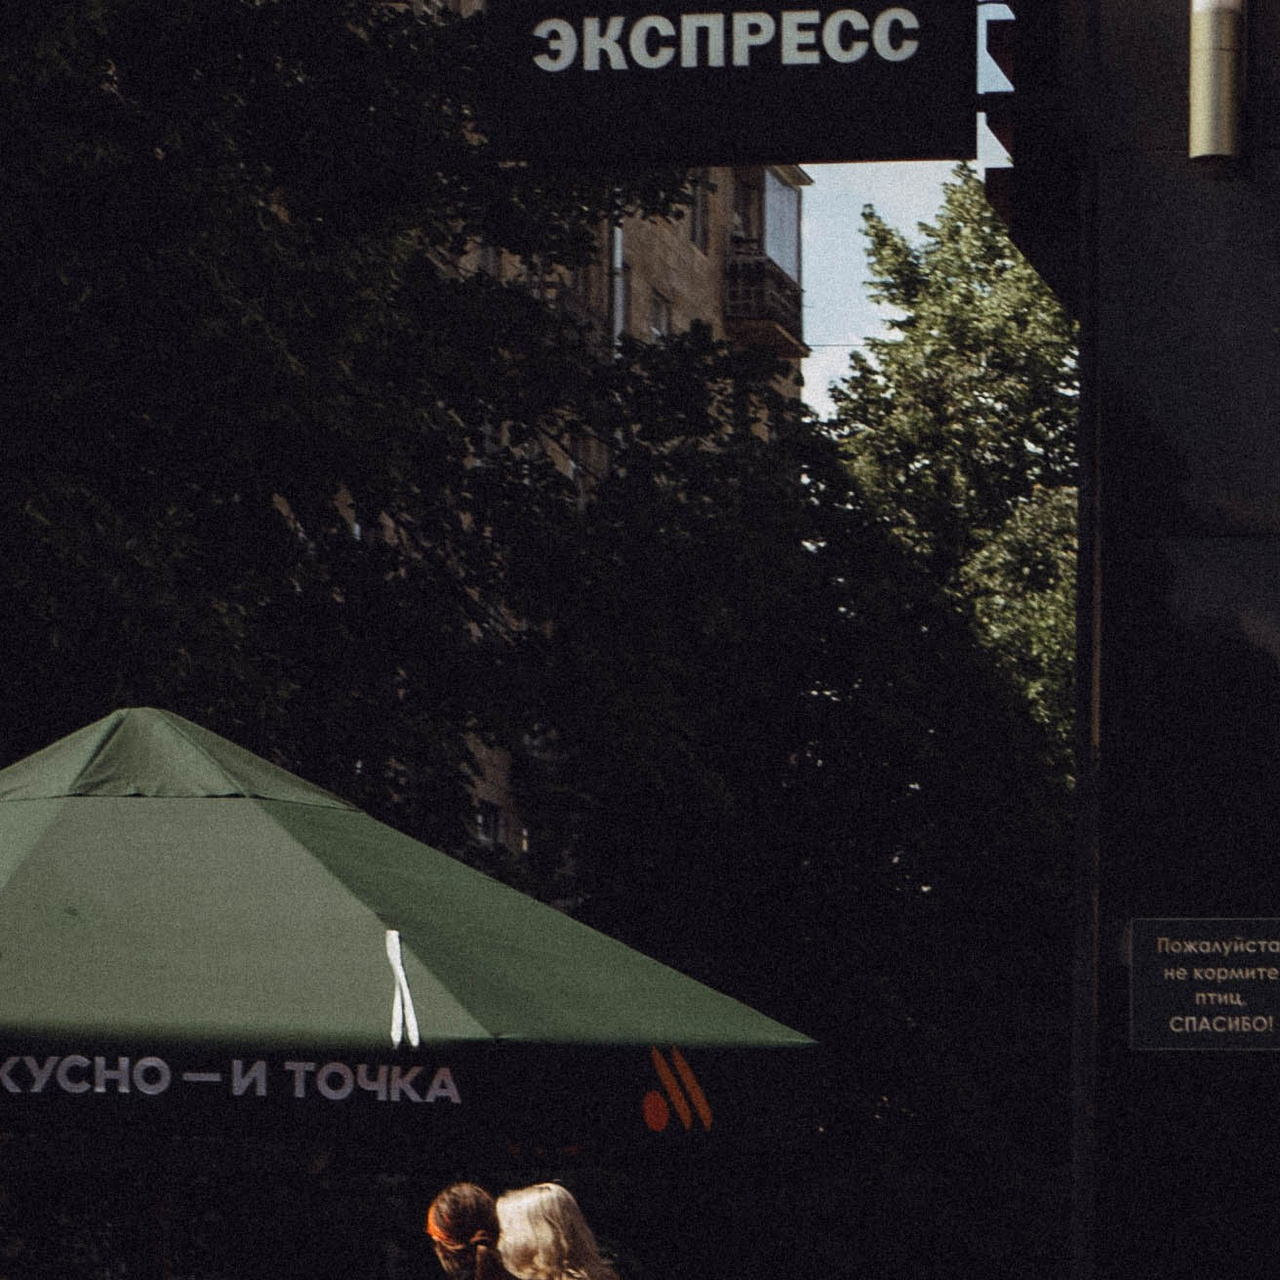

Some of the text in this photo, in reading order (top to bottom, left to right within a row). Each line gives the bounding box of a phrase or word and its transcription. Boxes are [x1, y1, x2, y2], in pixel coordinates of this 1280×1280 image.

[532, 6, 920, 73] ЭКСПРЕСС
[1163, 966, 1280, 984] не кормите
[1168, 1014, 1275, 1034] СПАСИБО!
[284, 1061, 462, 1104] ТОЧКА
